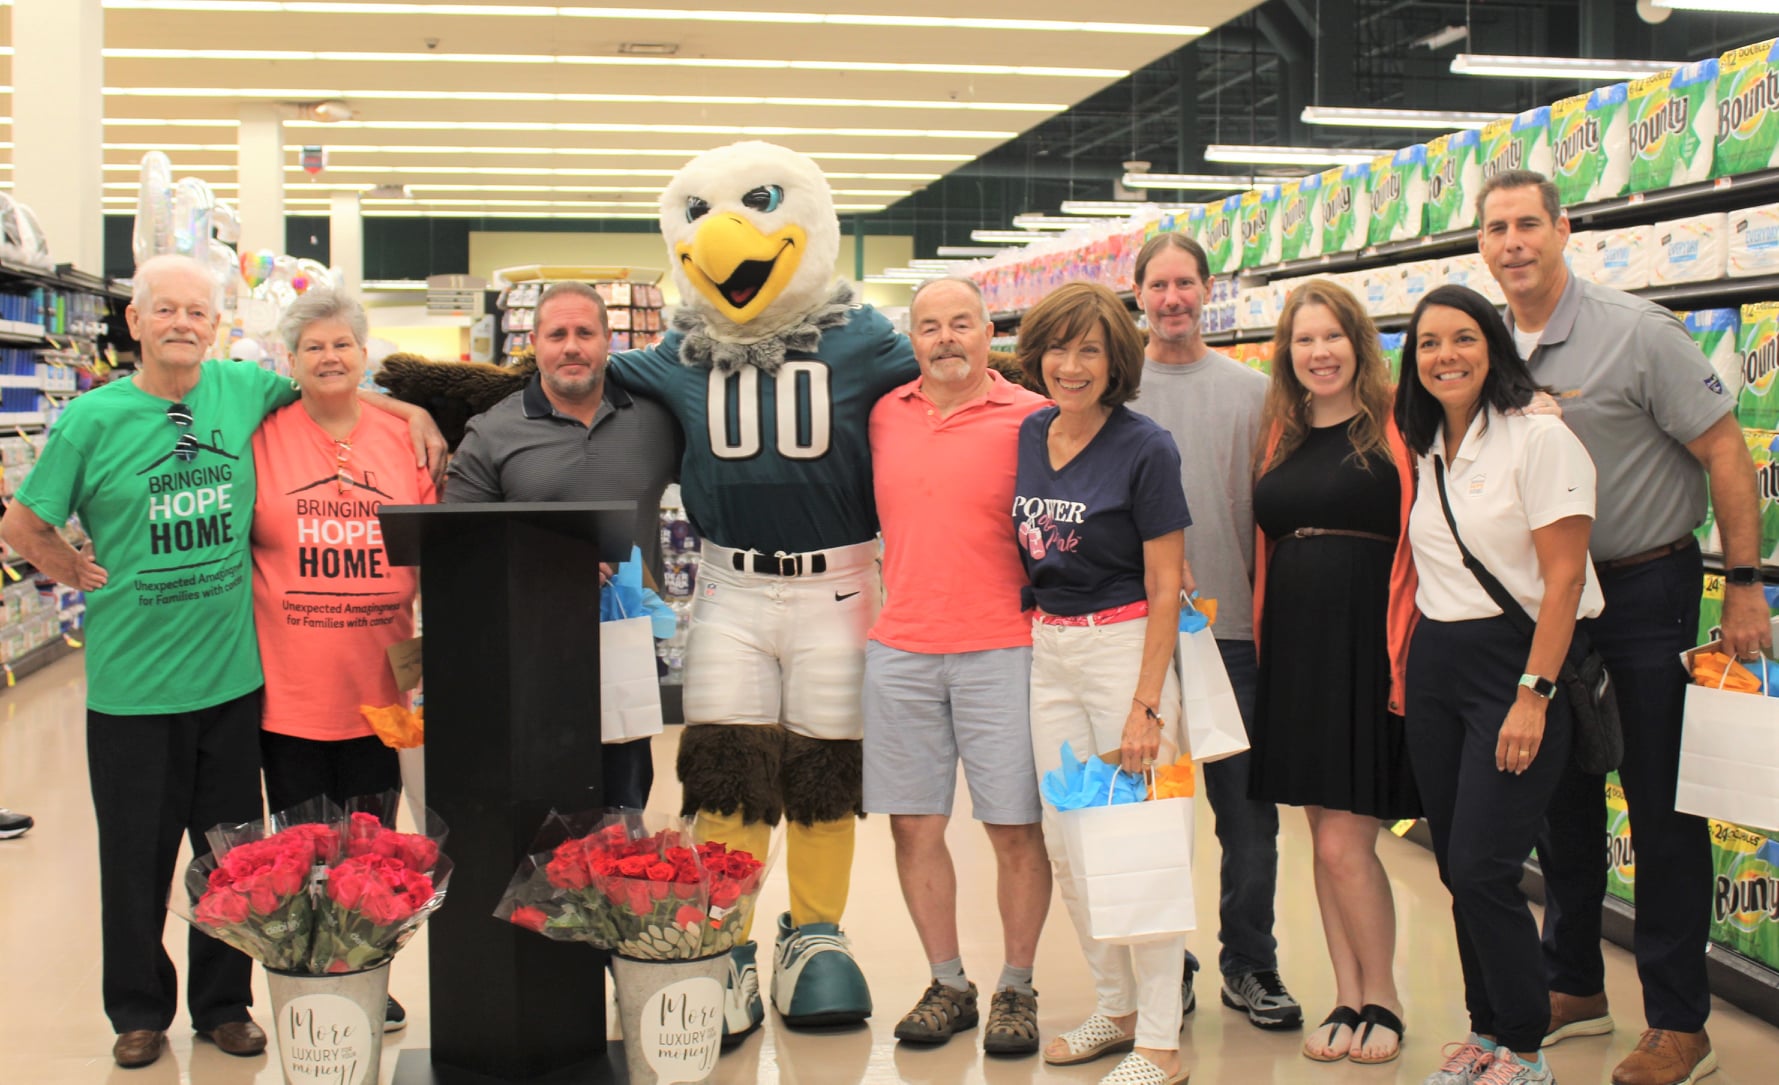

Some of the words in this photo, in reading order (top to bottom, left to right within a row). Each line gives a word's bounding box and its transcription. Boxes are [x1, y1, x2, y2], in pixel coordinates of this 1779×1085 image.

[1628, 95, 1688, 162] Bounty
[708, 360, 832, 461] 00
[149, 464, 232, 494] BRINGING
[149, 484, 233, 520] HOPE
[1012, 496, 1086, 524] POWER
[151, 512, 234, 554] HOME
[297, 518, 384, 545] HOPE
[299, 547, 384, 578] HOME
[135, 574, 196, 592] Unexpected
[139, 595, 153, 606] for
[156, 590, 200, 605] Families
[202, 585, 224, 599] with
[282, 600, 342, 615] Unexpected
[287, 614, 301, 625] for
[303, 617, 344, 629] Families
[347, 617, 368, 627] with
[1714, 823, 1729, 843] 24
[290, 1006, 357, 1047] More
[660, 993, 717, 1032] More
[659, 1030, 705, 1046] LUXURY
[291, 1046, 340, 1061] LUXURY
